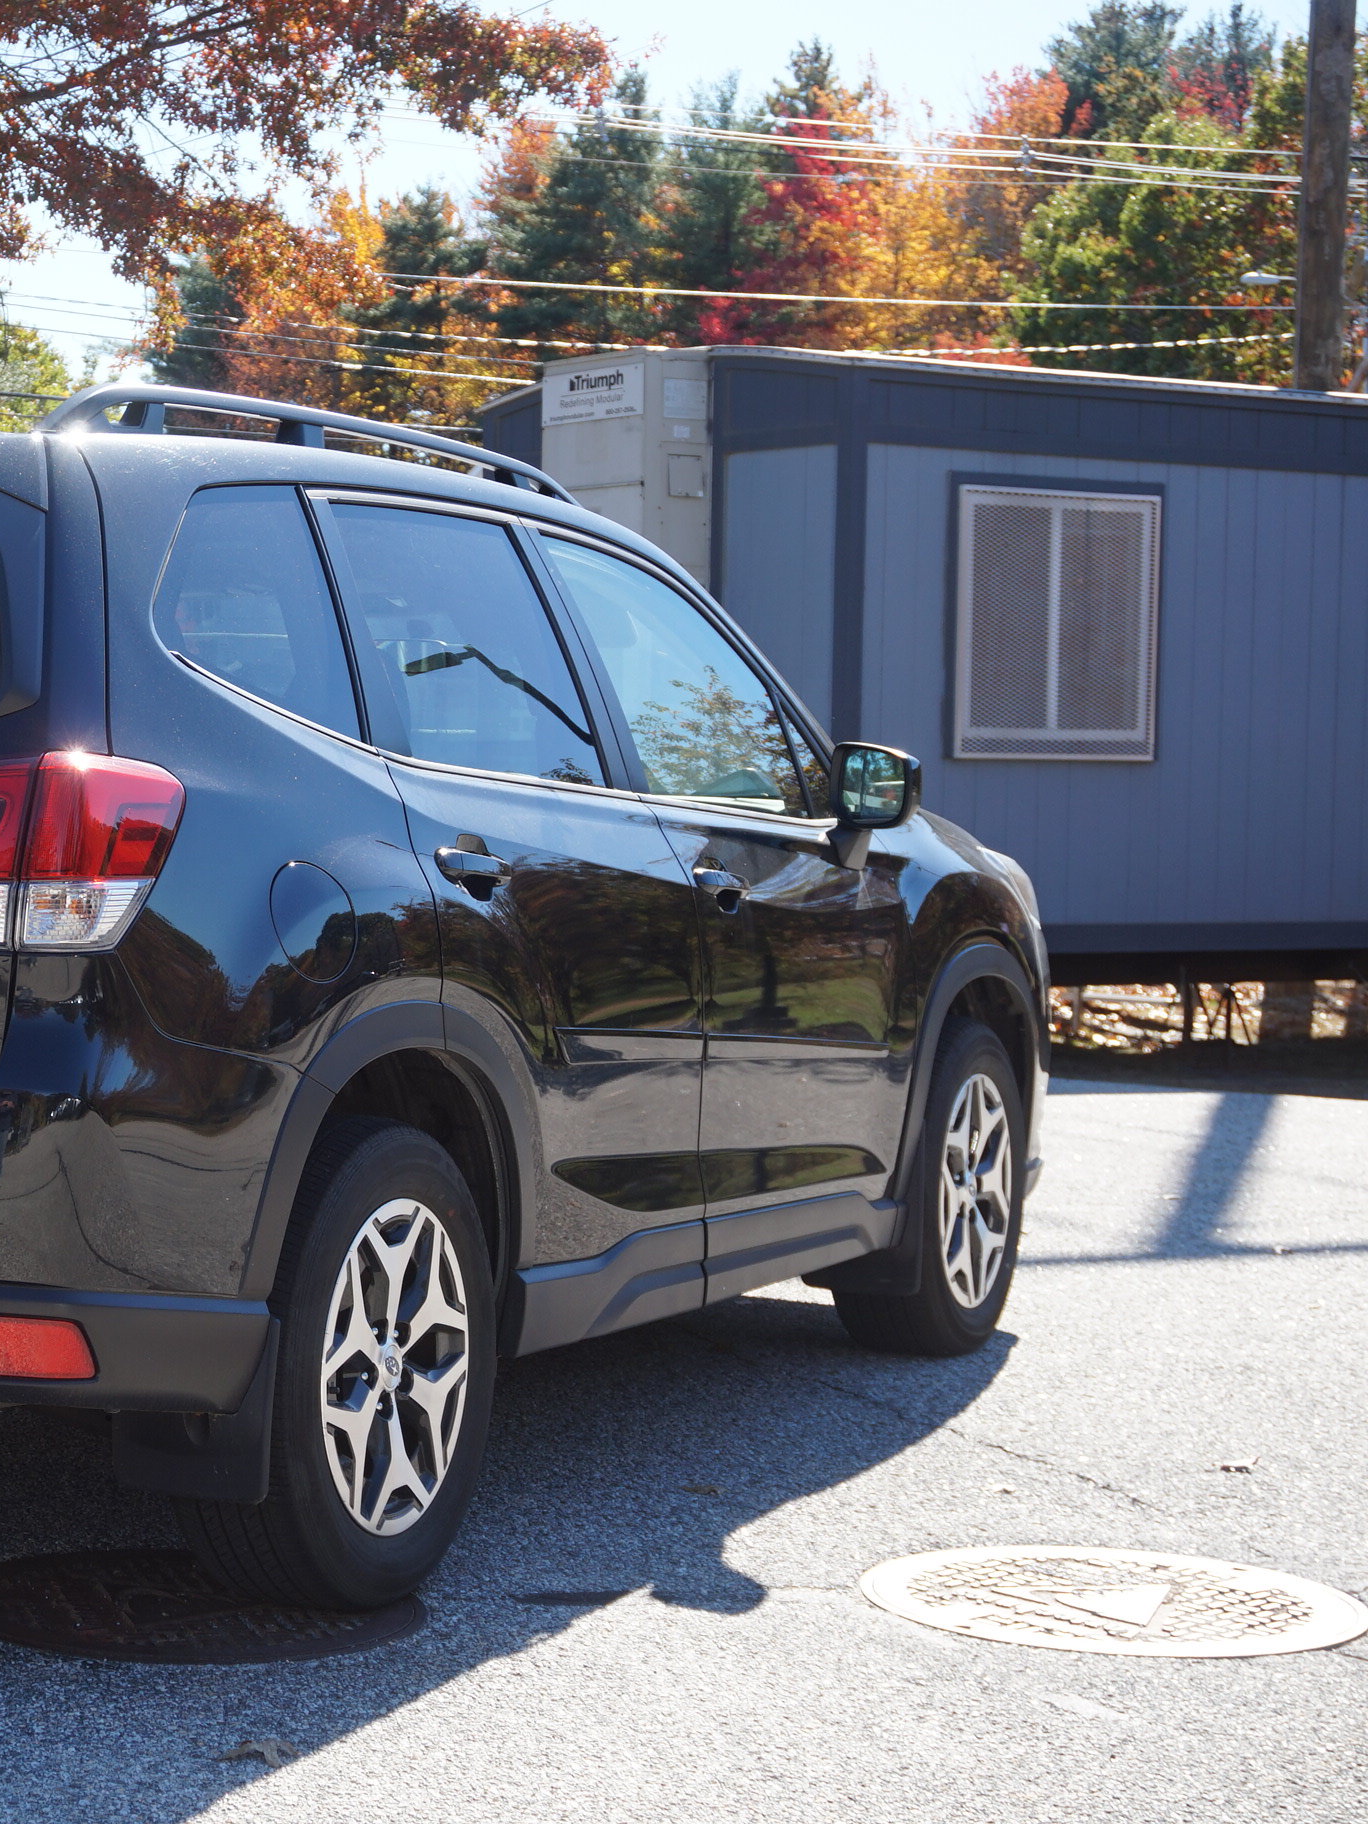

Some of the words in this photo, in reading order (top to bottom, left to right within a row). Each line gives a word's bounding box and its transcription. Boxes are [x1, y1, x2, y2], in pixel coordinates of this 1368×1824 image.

[574, 369, 624, 391] Triumph
[560, 396, 594, 409] Redefining
[596, 393, 623, 404] Modular
